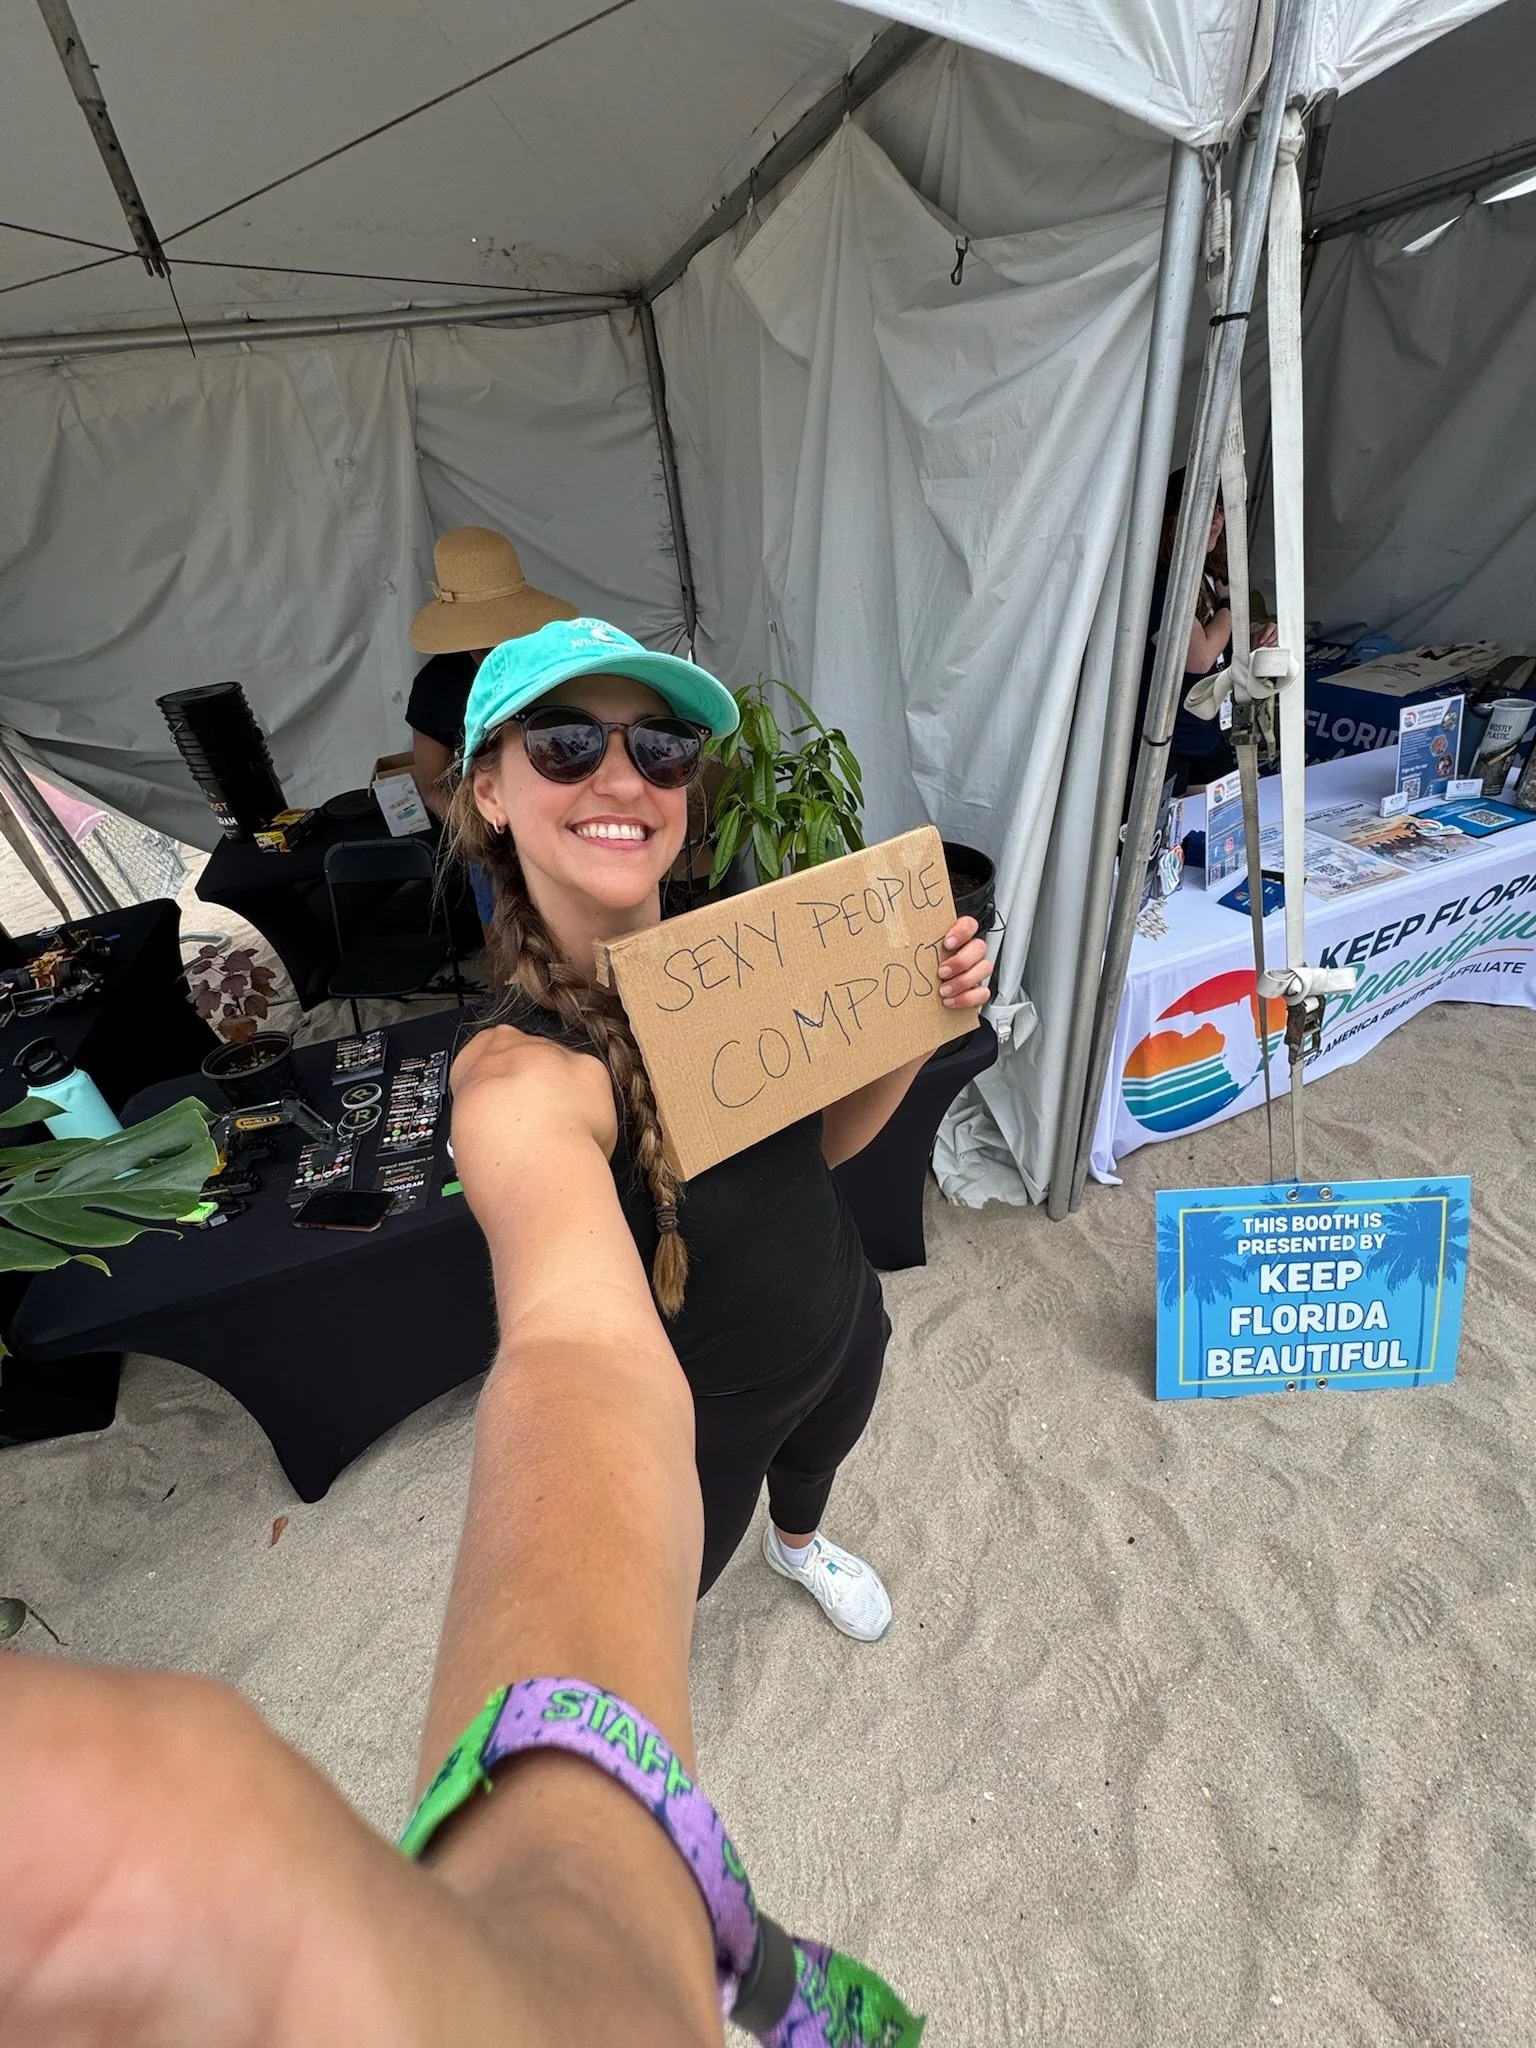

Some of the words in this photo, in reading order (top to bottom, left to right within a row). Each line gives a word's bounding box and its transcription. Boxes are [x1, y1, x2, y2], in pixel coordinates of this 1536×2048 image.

[1489, 723, 1513, 732] MOSTLY
[656, 911, 784, 1012] SEXY
[796, 862, 944, 949] PEOPLE
[1319, 914, 1426, 968] KEEP
[1425, 874, 1536, 936] FLORI
[711, 935, 946, 1108] COMPOST
[1323, 1015, 1379, 1056] AMERICA
[1443, 962, 1527, 983] AFFILIATE
[383, 1172, 426, 1187] COMPOST
[398, 1157, 426, 1167] Members
[1242, 1217, 1288, 1234] THIS
[1291, 1213, 1359, 1231] BOOTH
[1362, 1212, 1383, 1229] IS
[1237, 1235, 1356, 1255] PRESENTED
[1359, 1232, 1387, 1250] BY
[1260, 1260, 1364, 1294] KEEP
[1230, 1300, 1389, 1337] FLORIDA
[1206, 1340, 1408, 1378] BEAUTIFUL
[542, 1689, 693, 1797] STAFF
